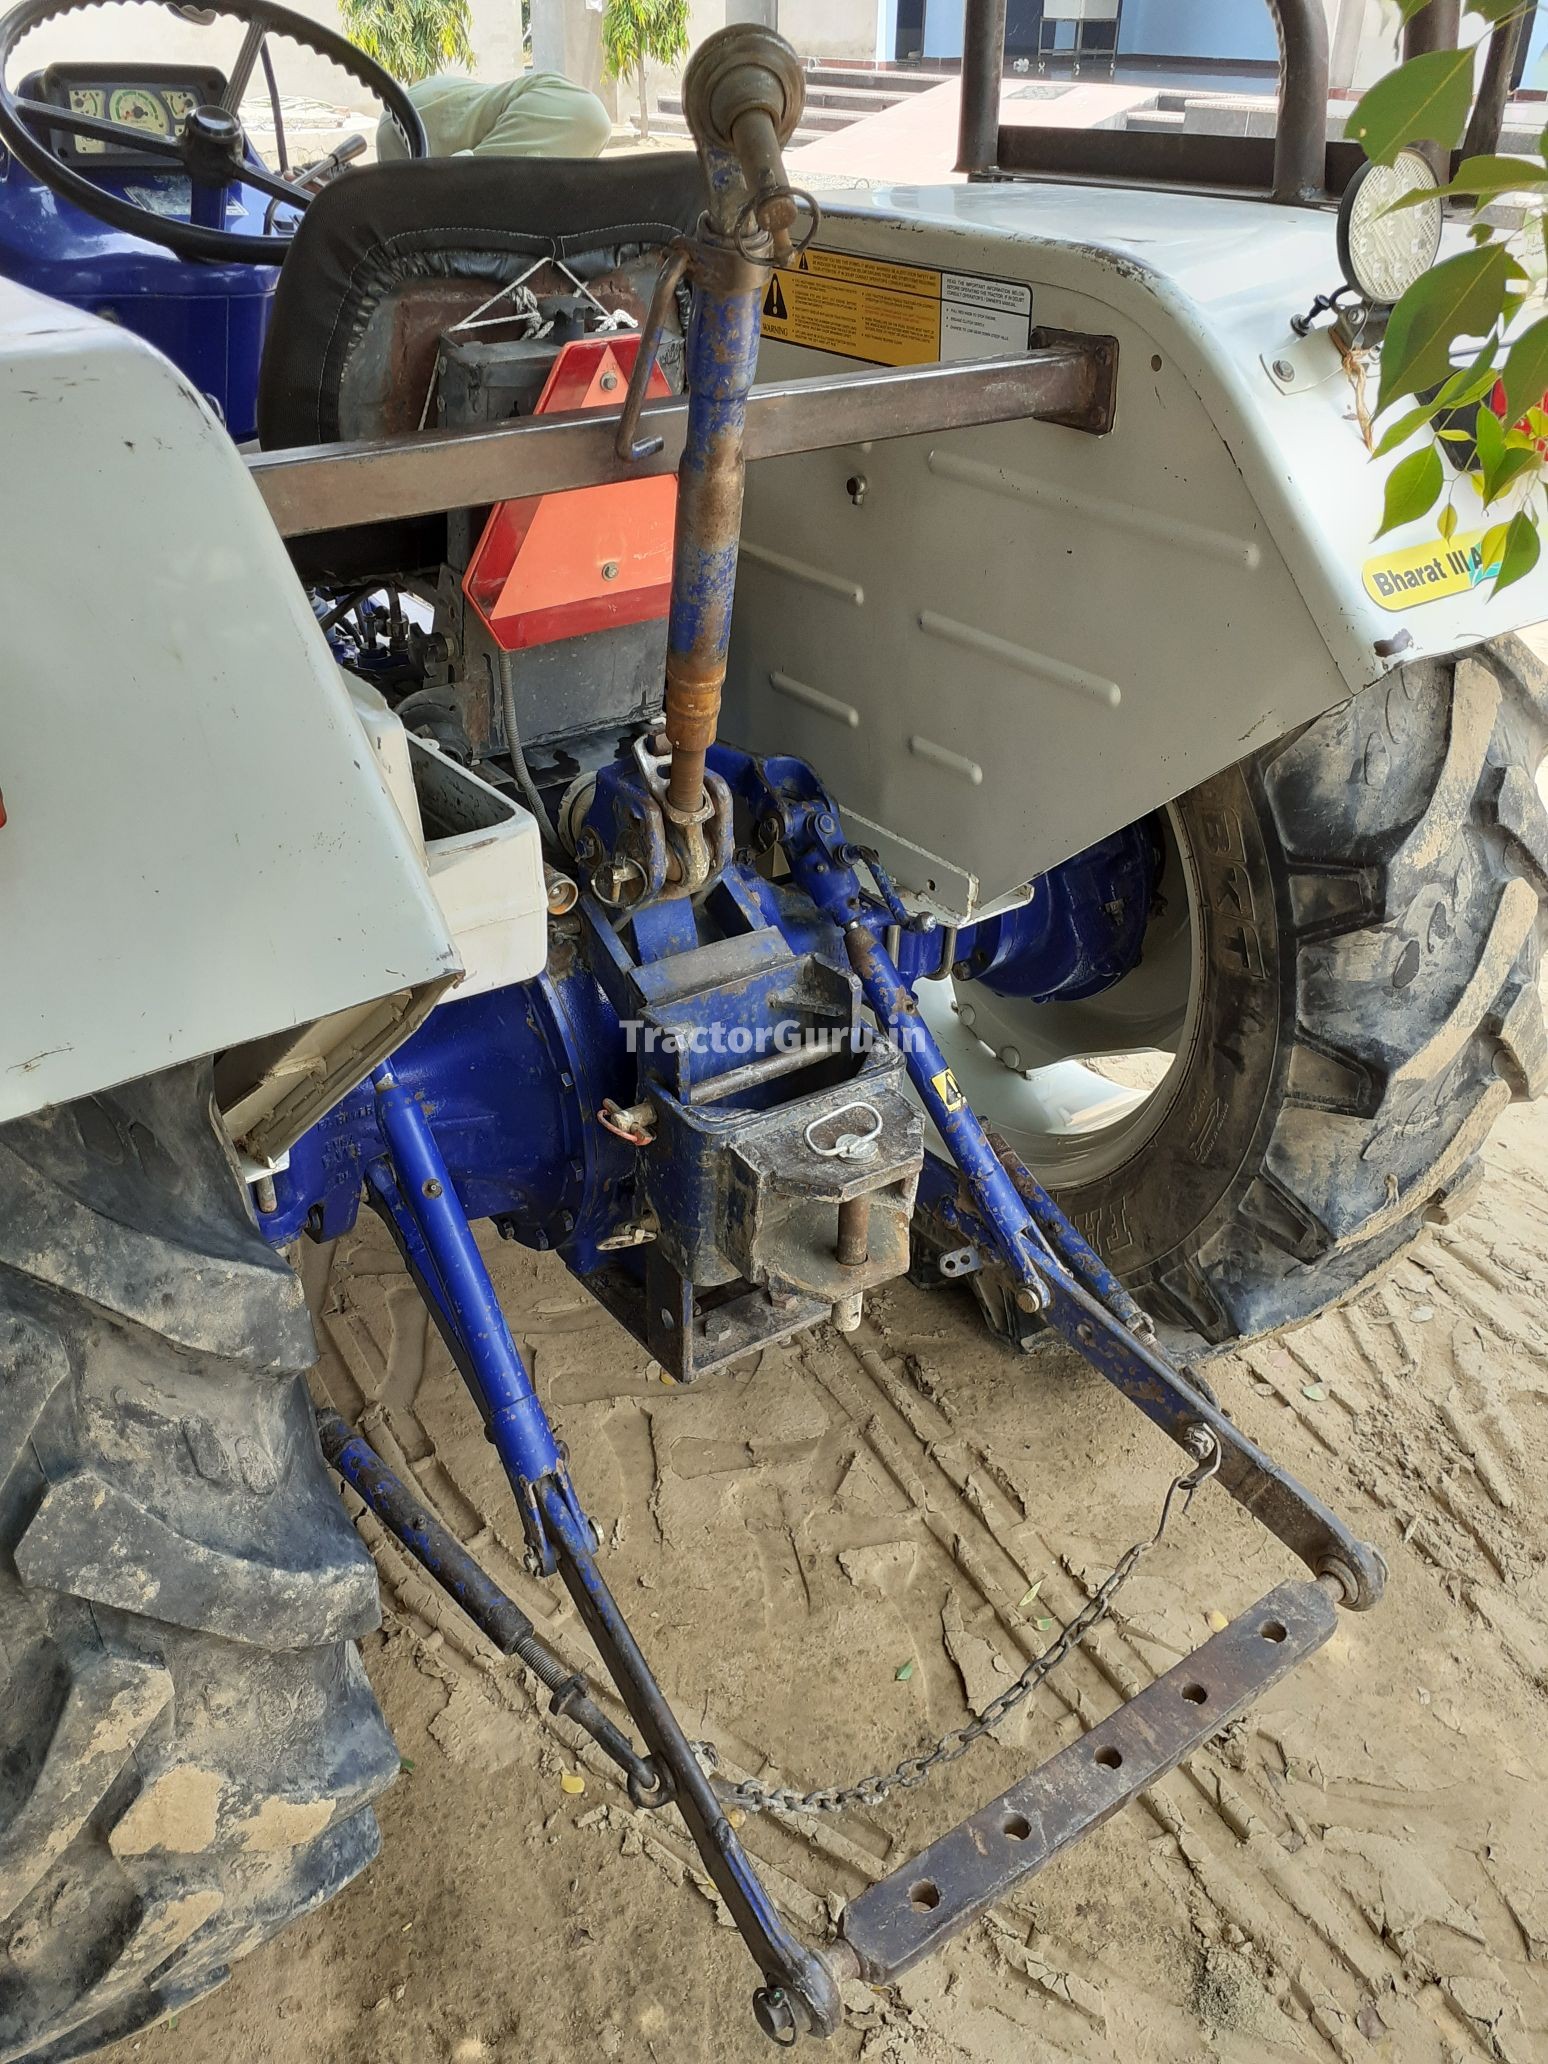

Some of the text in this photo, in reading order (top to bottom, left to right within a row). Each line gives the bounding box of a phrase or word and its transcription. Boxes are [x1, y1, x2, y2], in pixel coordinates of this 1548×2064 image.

[763, 323, 788, 336] WARNING
[1372, 558, 1447, 597] Bharat
[1446, 550, 1471, 575] III
[1203, 806, 1265, 979] BKT
